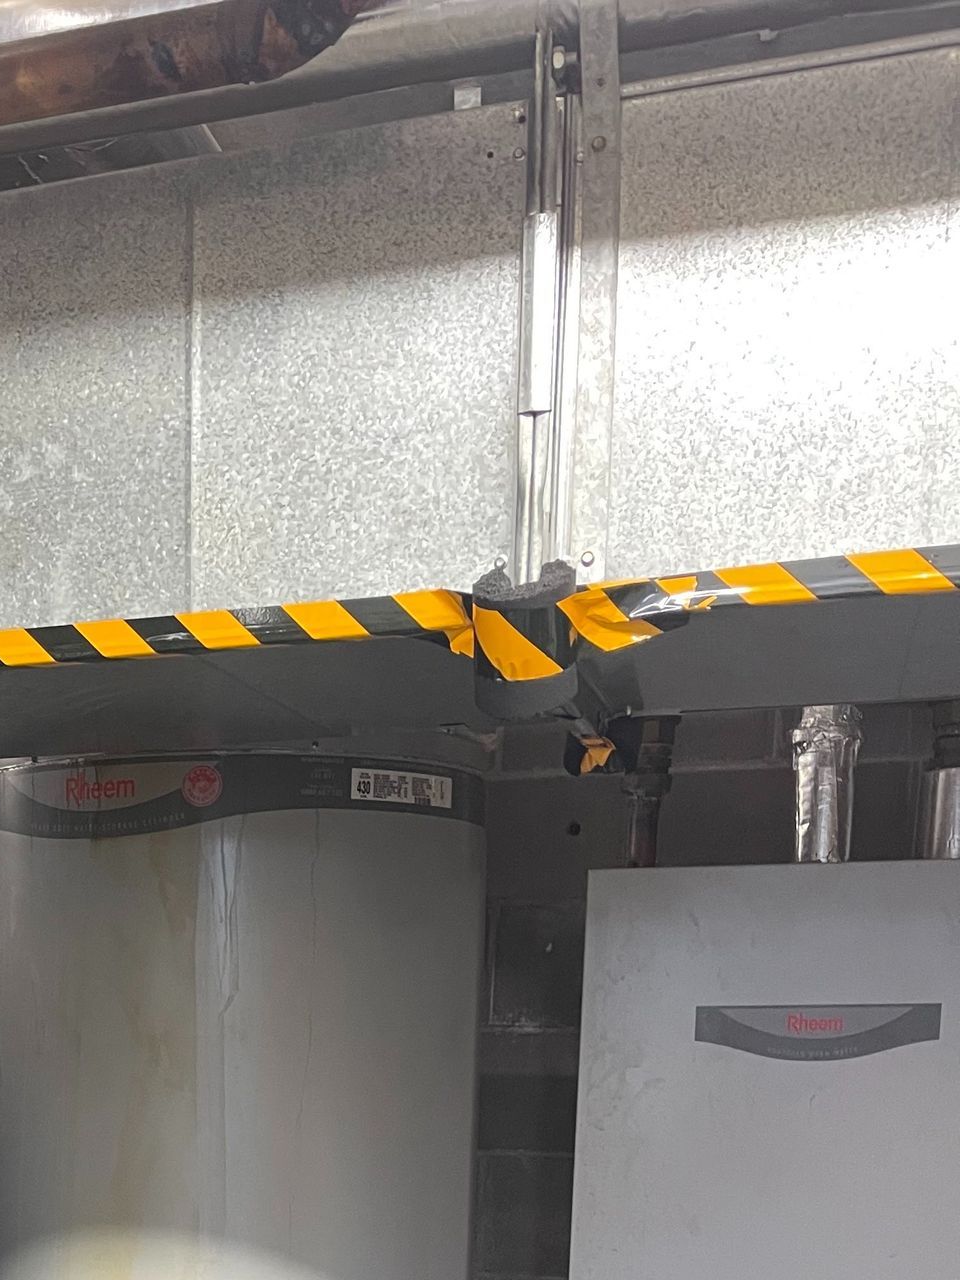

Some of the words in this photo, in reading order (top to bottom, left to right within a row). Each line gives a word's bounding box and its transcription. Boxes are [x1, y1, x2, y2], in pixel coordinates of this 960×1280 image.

[65, 771, 135, 808] Rheem
[356, 780, 372, 795] 430
[785, 1012, 844, 1035] Rheem
